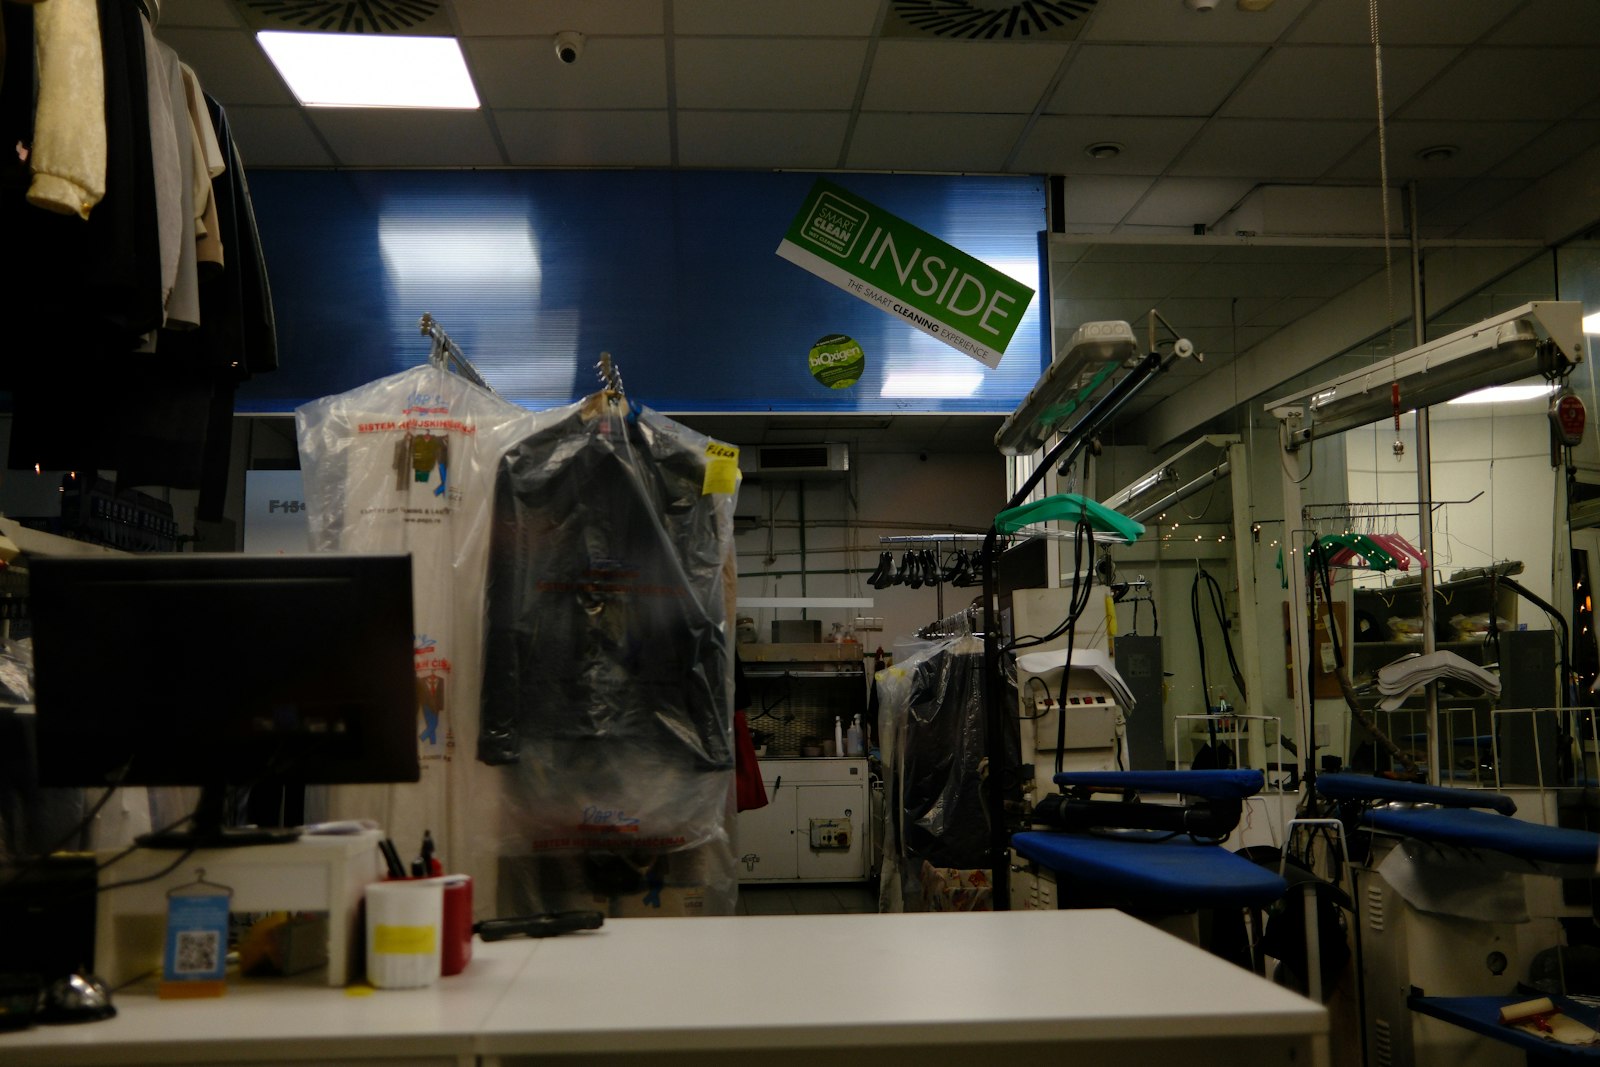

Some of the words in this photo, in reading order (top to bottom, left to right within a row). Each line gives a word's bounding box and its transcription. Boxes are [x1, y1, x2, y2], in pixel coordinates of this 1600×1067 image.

[813, 217, 851, 242] CLEAN
[819, 207, 857, 232] SMART
[859, 226, 1017, 336] INSIDE
[847, 279, 863, 292] THE
[863, 288, 893, 308] SMART
[893, 304, 940, 333] CLEANING
[940, 329, 989, 359] EXPERIENCE
